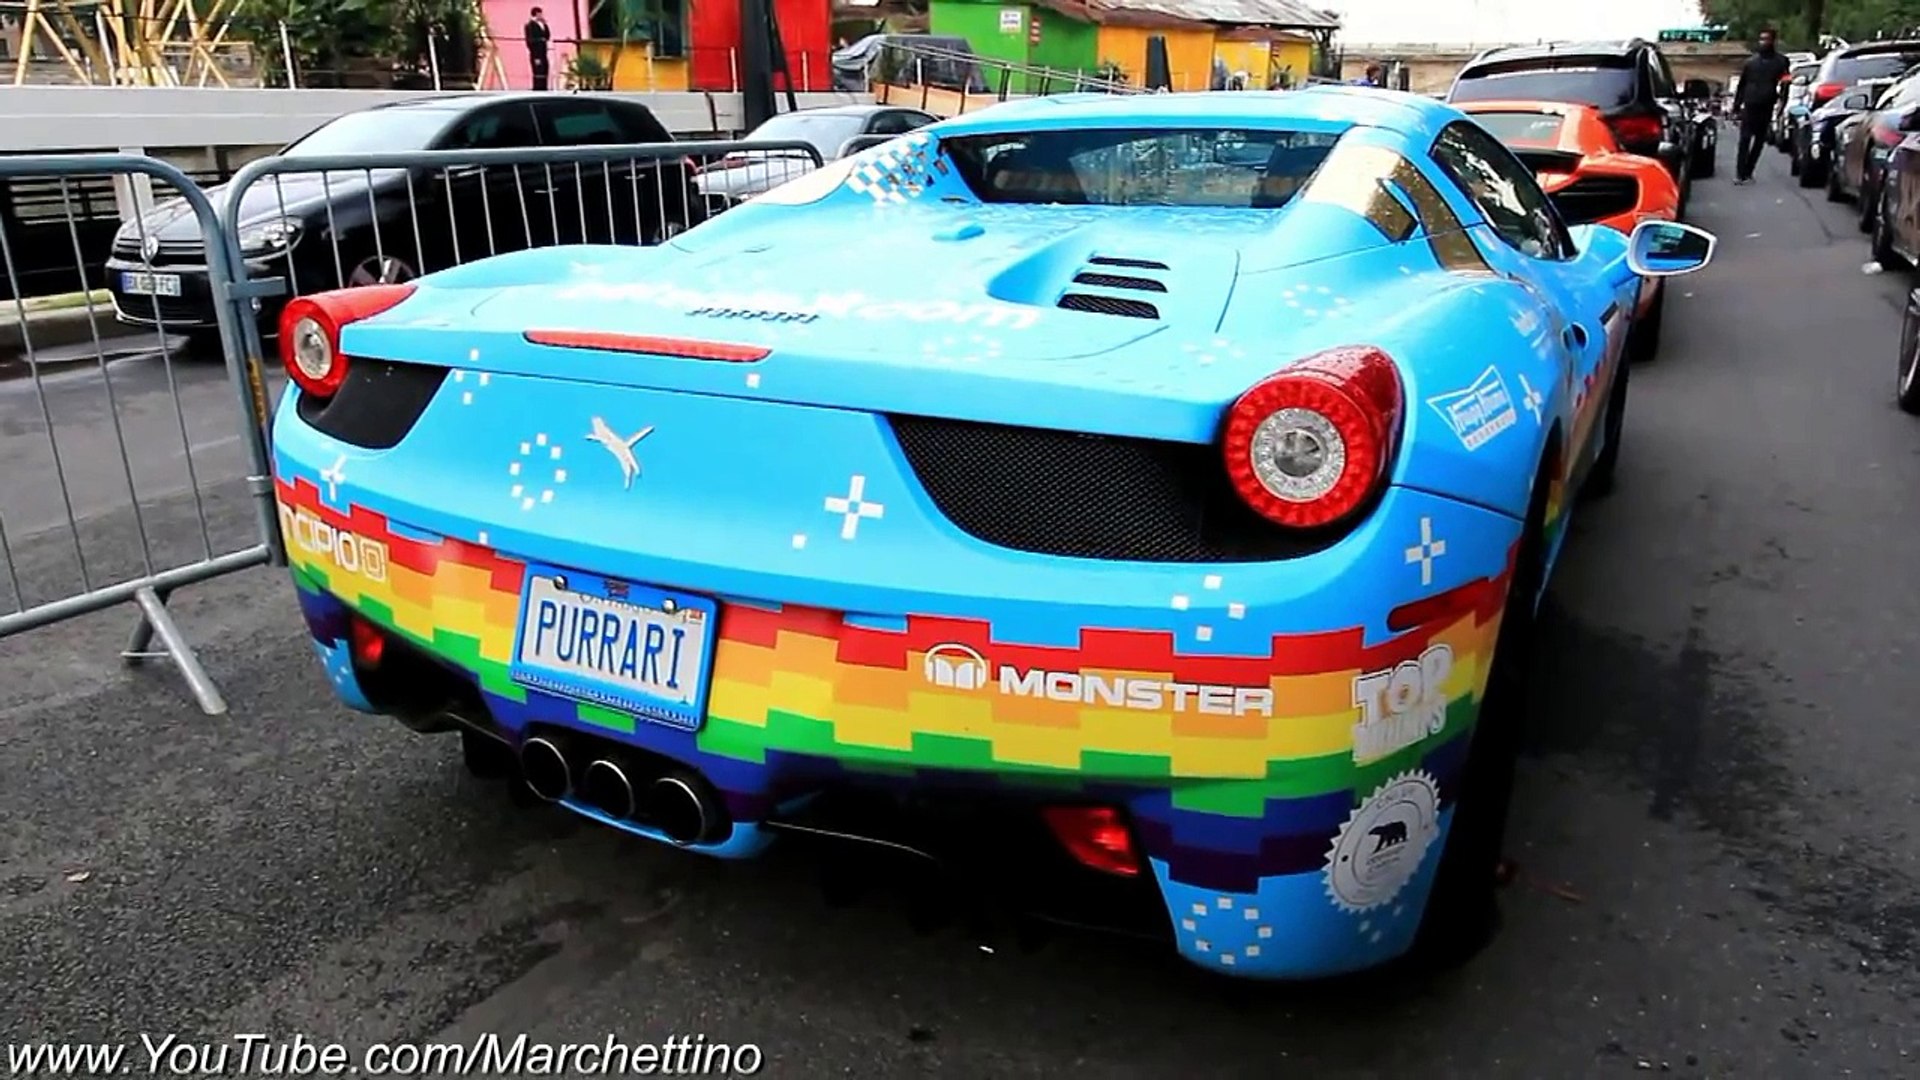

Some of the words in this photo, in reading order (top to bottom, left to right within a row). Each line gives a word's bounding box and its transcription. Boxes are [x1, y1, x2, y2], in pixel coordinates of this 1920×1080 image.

[535, 600, 686, 689] PURRARI
[1352, 644, 1453, 728] TOP
[1000, 665, 1274, 717] MONSTER
